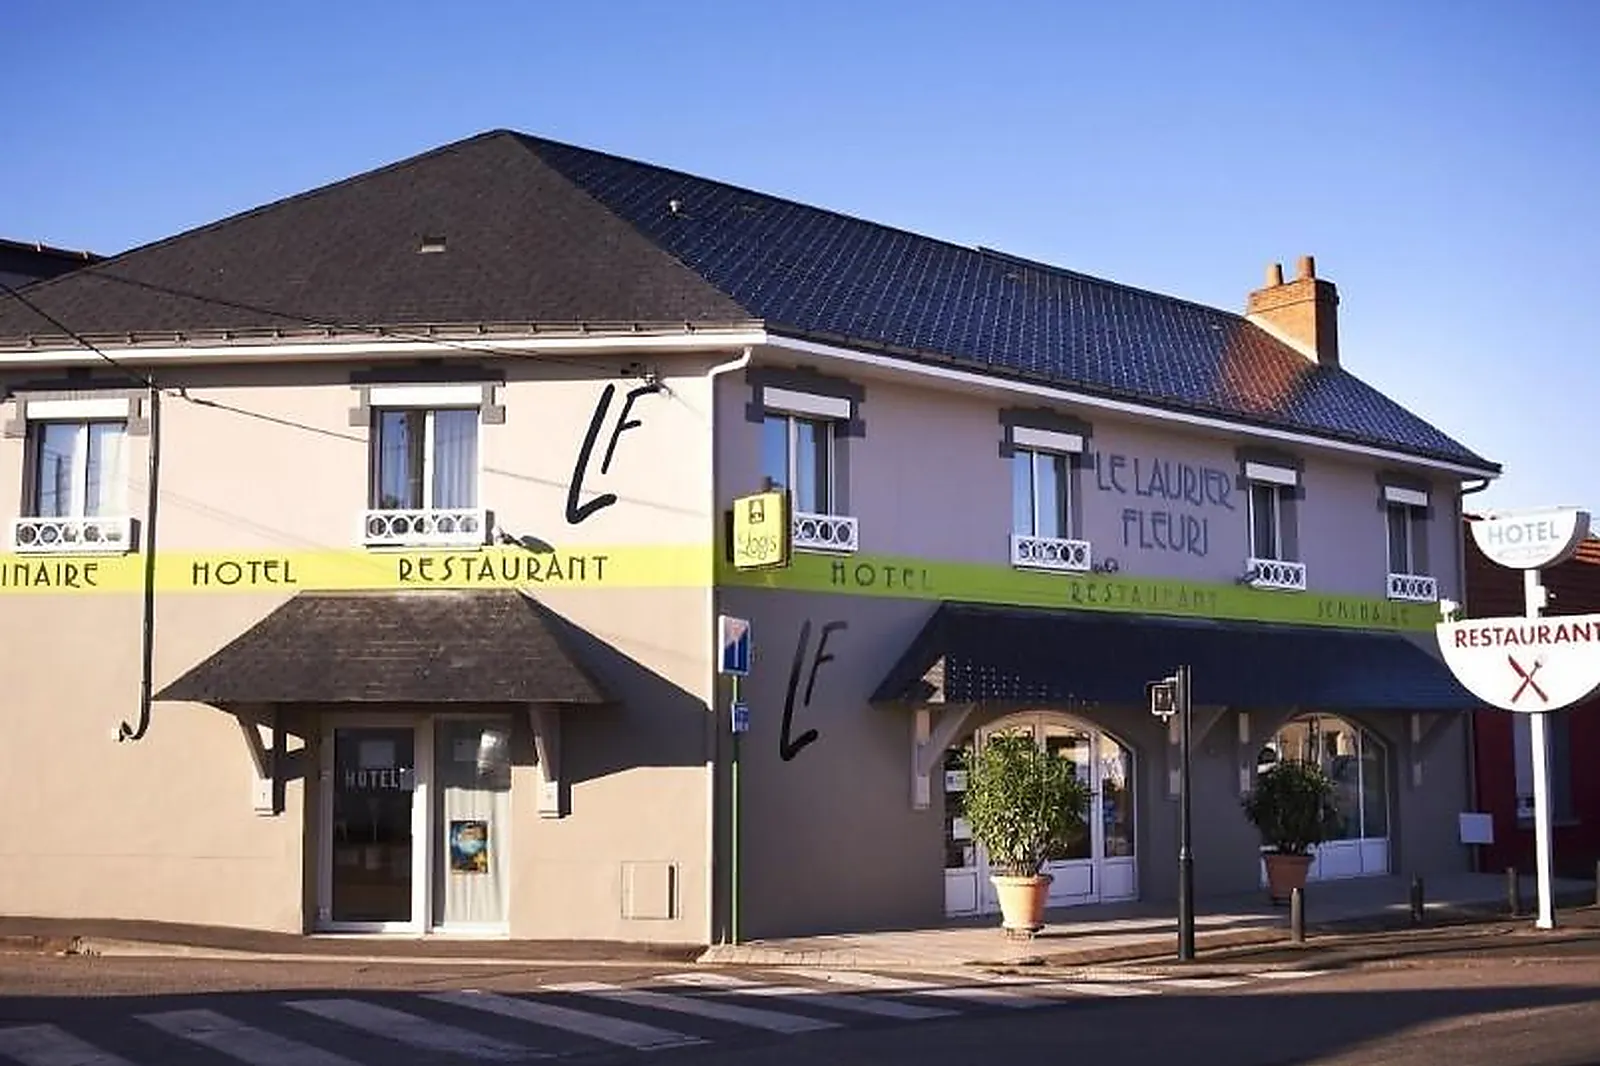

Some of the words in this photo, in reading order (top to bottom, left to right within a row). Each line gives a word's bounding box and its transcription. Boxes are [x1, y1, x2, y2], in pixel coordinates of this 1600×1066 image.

[1096, 449, 1127, 494] LE
[1134, 457, 1236, 511] LAURIER
[1122, 508, 1209, 557] FLEURI
[1488, 521, 1560, 545] HOTEL
[192, 560, 297, 586] HOTEL
[398, 554, 608, 582] RESTAURANT
[832, 560, 934, 591] HOTEL
